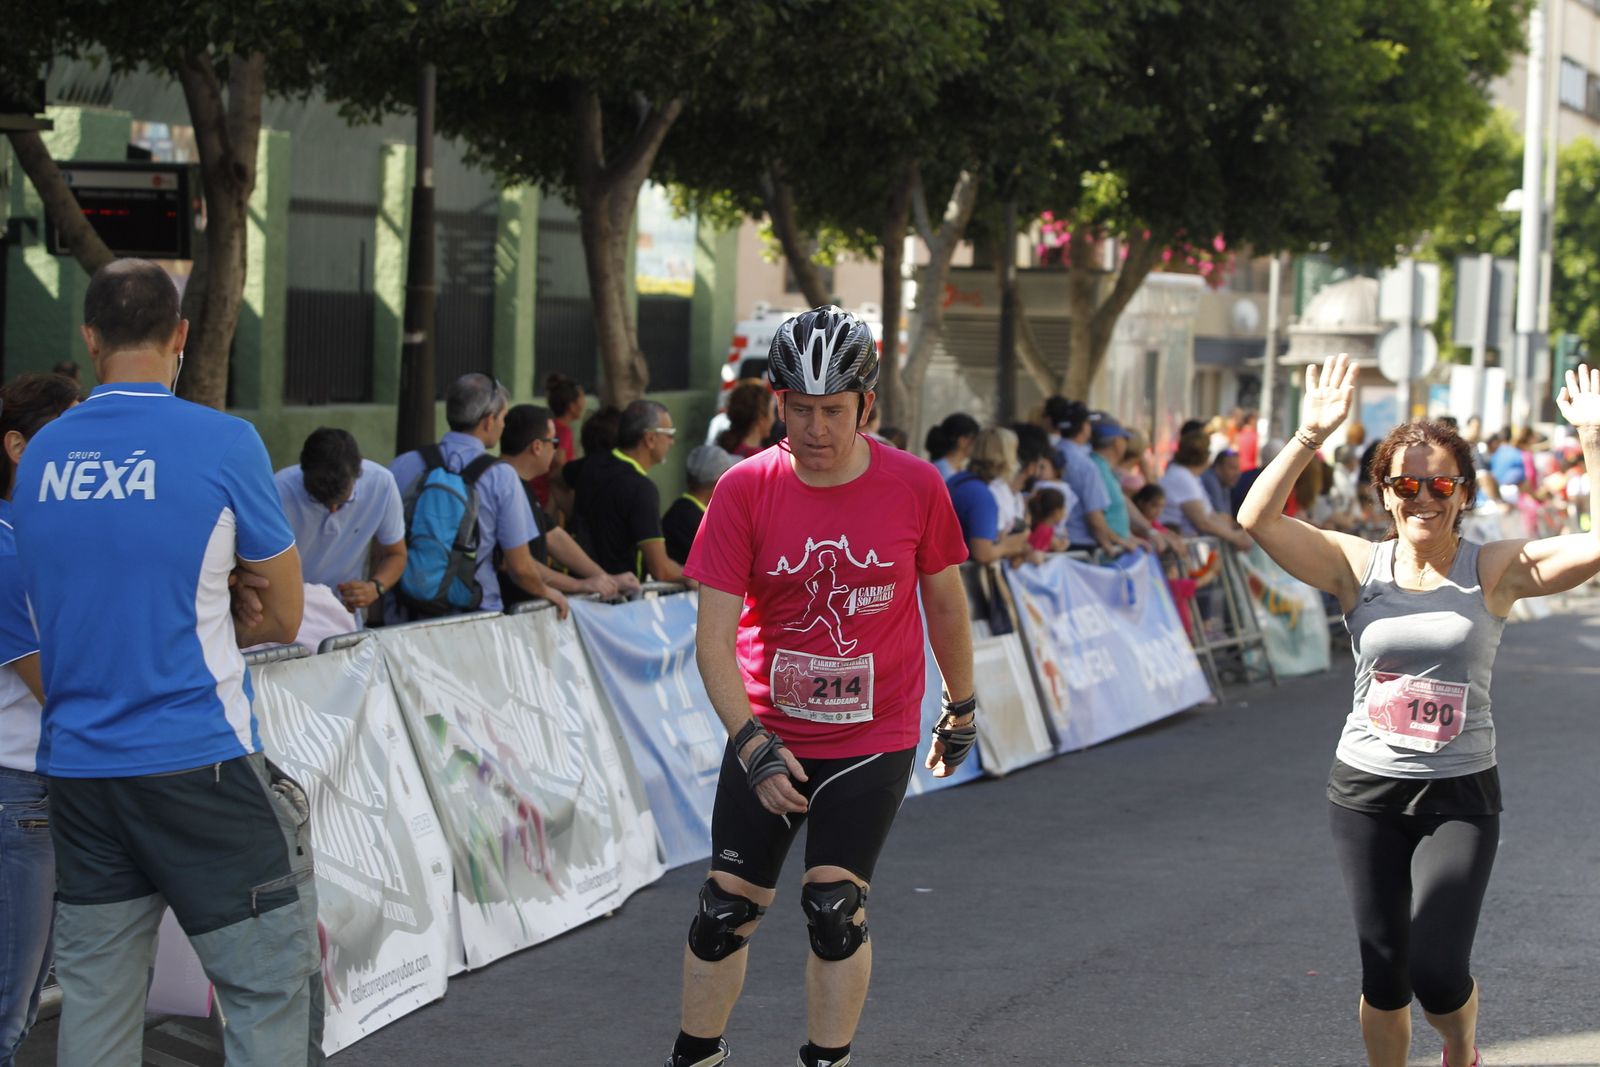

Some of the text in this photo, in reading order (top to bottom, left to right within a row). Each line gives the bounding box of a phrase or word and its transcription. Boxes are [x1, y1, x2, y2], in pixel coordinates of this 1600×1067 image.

[68, 451, 101, 460] GRUPO
[842, 588, 858, 616] 4
[812, 676, 862, 698] 214
[808, 697, 860, 706] M.A. GALDEANO
[1407, 698, 1455, 727] 190
